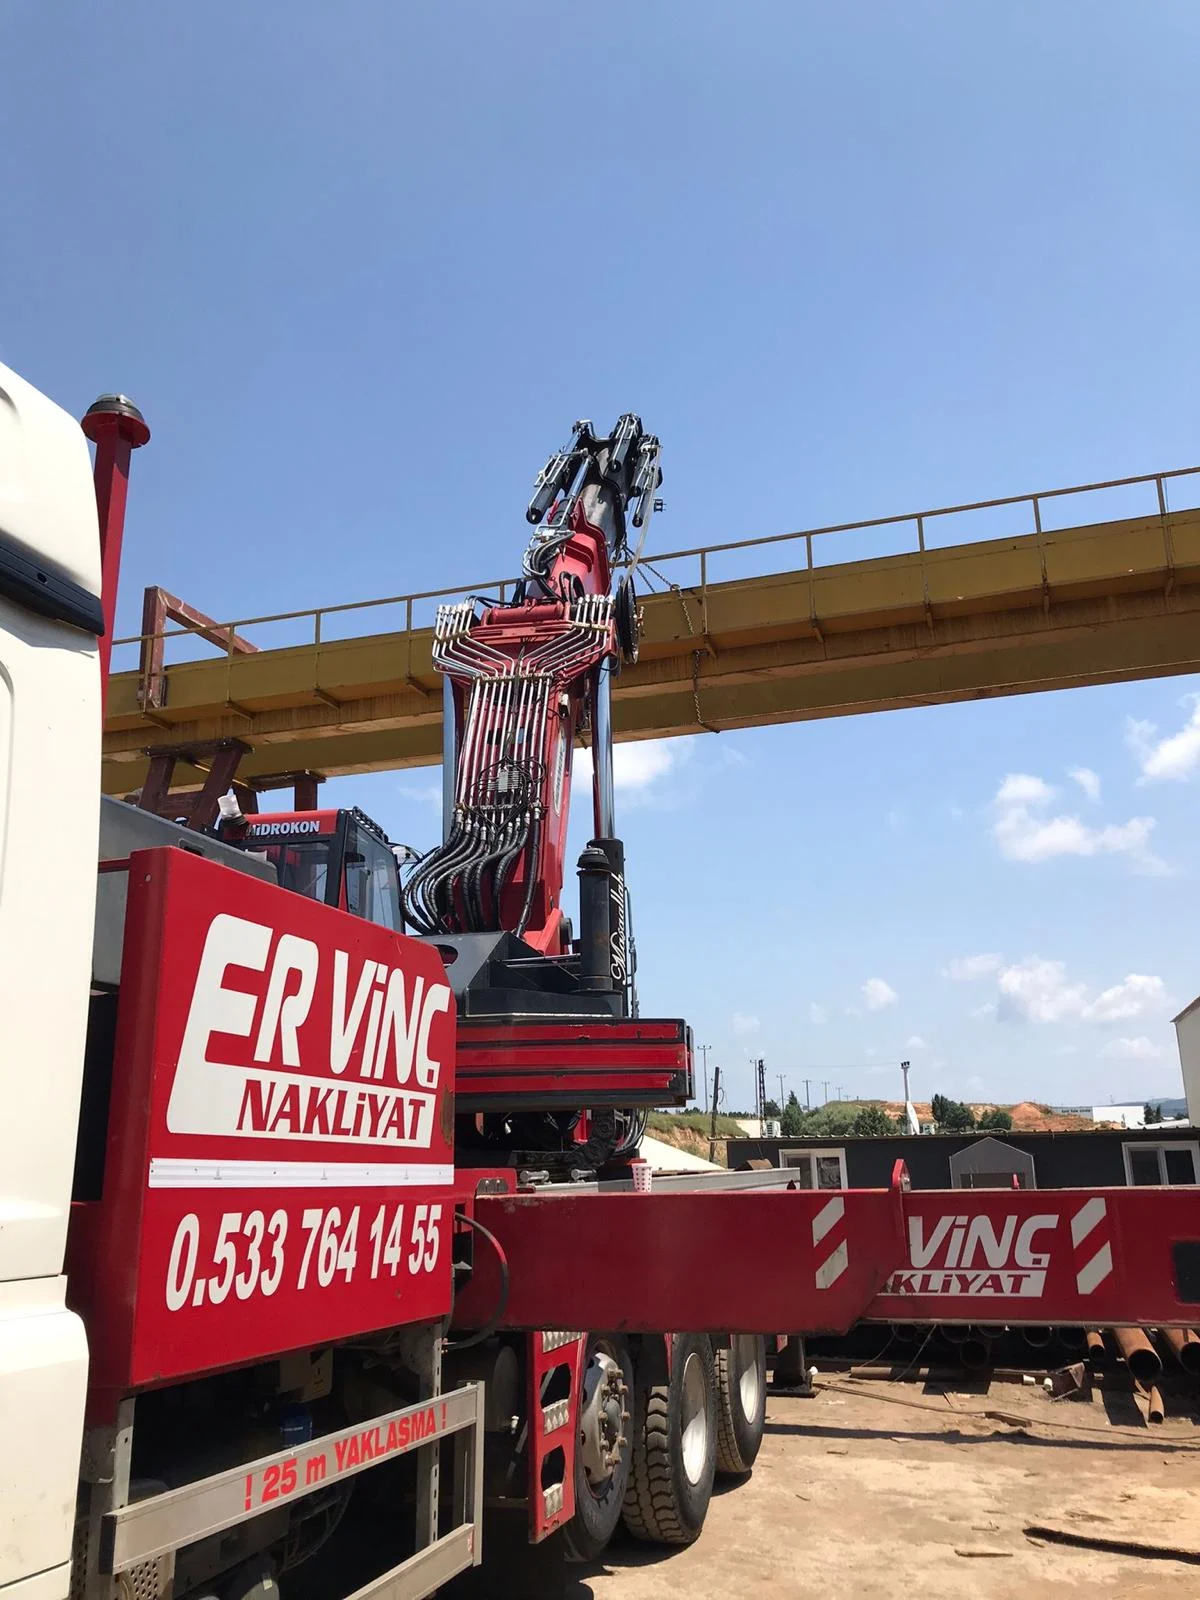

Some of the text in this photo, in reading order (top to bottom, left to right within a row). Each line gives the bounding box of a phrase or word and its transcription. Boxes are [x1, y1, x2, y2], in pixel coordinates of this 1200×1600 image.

[166, 913, 319, 1133] ER
[165, 1204, 442, 1311] 0.533 764 14 55
[262, 1458, 298, 1503] 25
[306, 1454, 326, 1485] m
[334, 1407, 437, 1472] YAKLAŞMA
